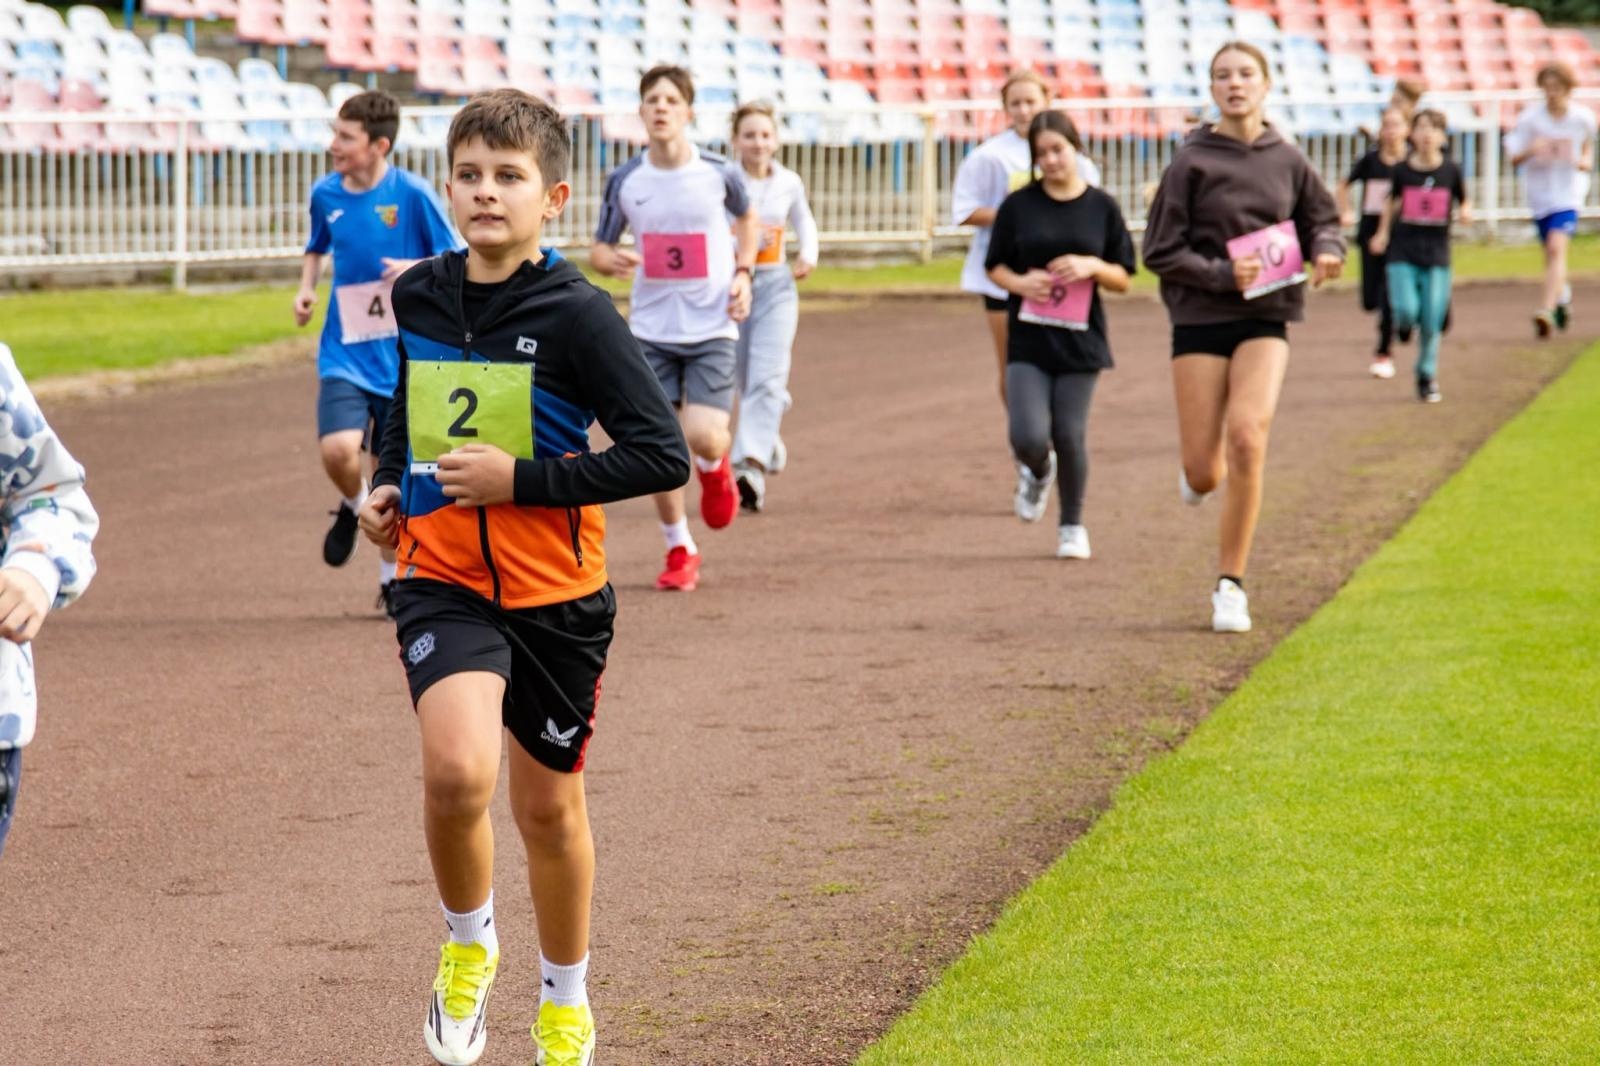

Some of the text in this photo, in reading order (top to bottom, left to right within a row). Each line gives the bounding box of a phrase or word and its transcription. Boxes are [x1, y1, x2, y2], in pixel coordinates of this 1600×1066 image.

[666, 247, 684, 271] 3
[1255, 242, 1285, 271] 10
[368, 294, 386, 318] 4
[1050, 284, 1067, 308] 9
[448, 387, 478, 437] 2
